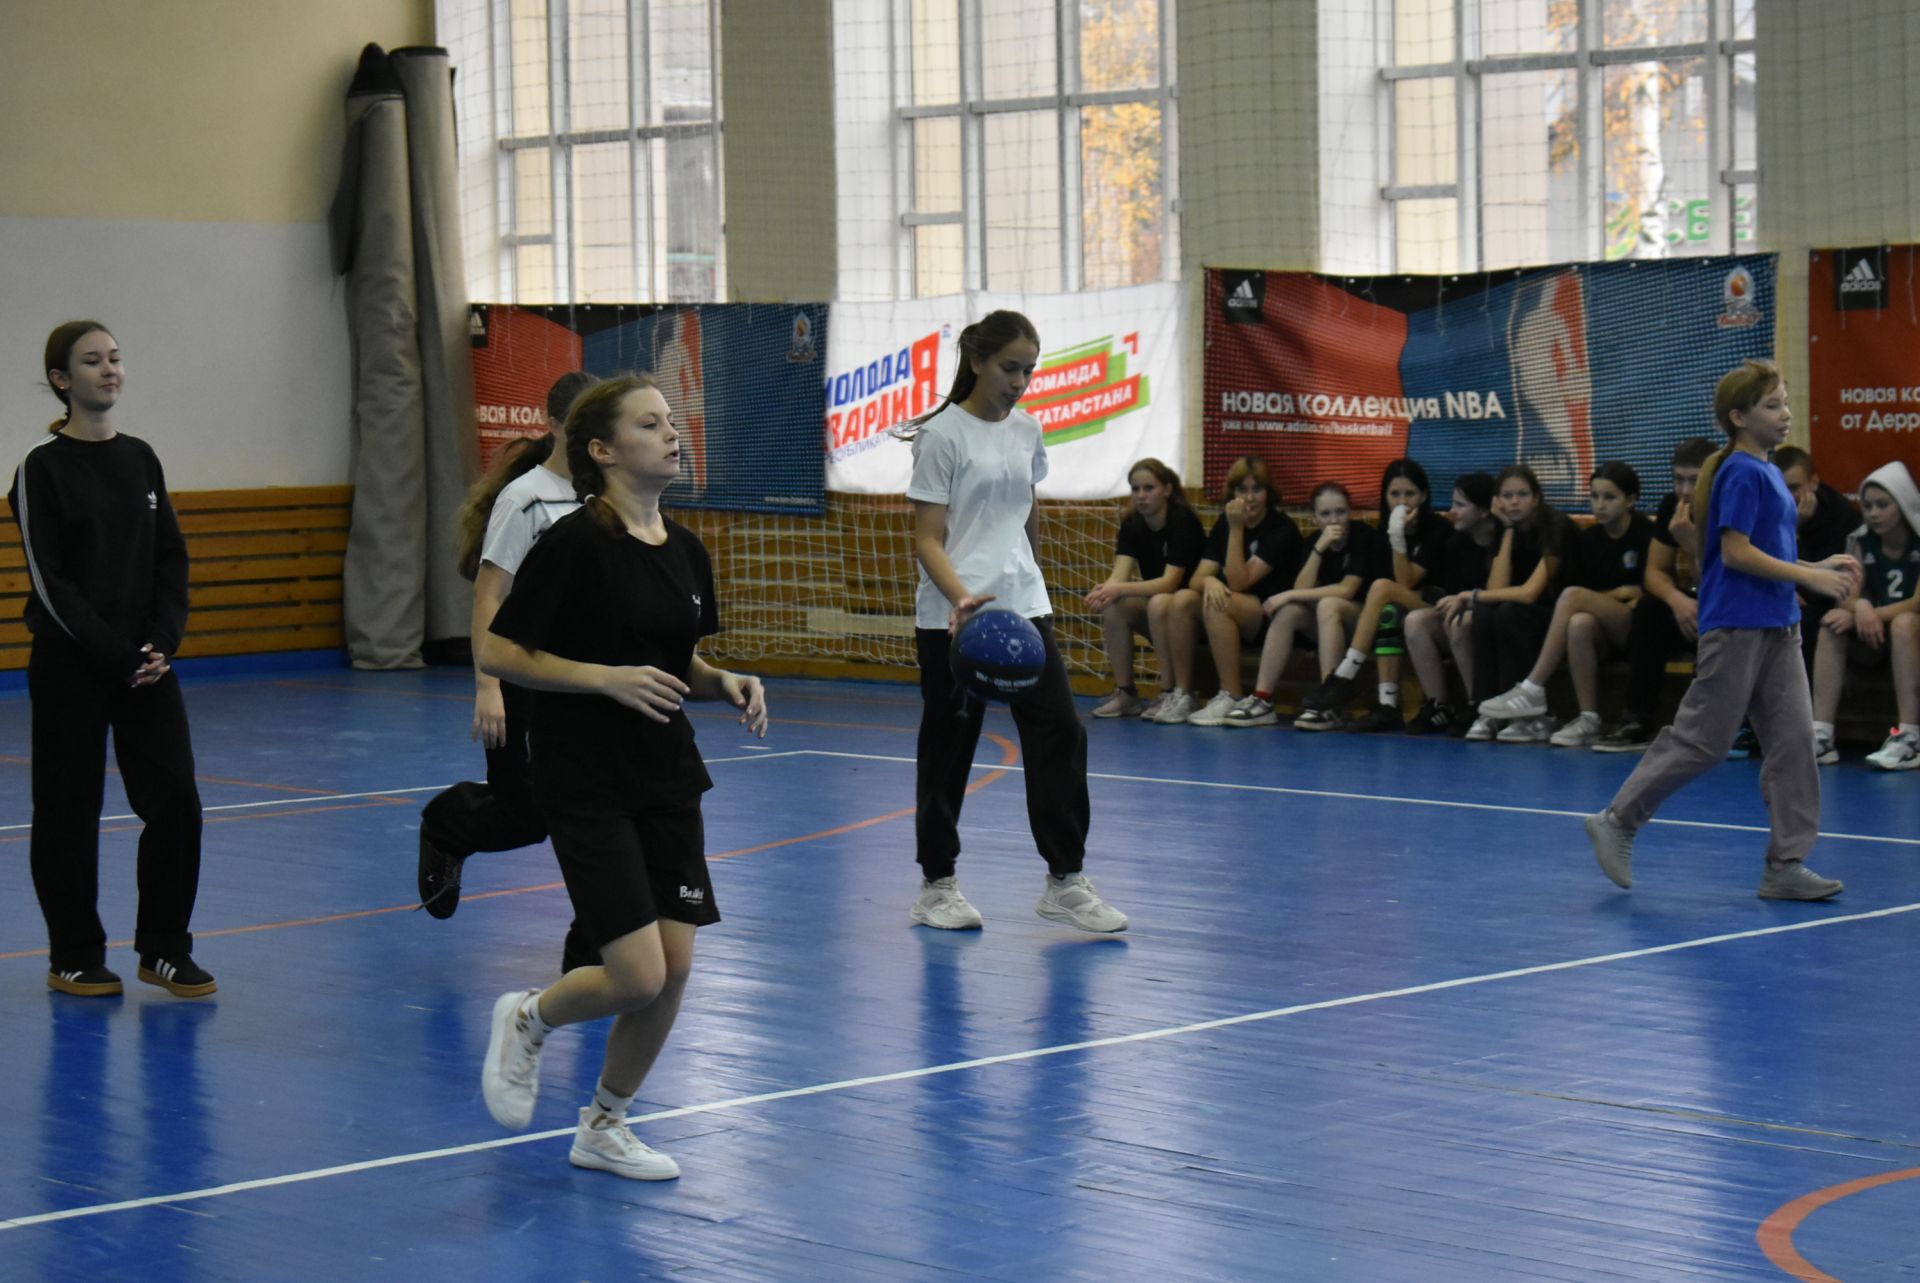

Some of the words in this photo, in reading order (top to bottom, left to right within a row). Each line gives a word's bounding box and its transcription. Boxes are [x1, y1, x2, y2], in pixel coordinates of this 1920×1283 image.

[1841, 279, 1881, 292] adidas
[1444, 390, 1506, 419] NBA
[1841, 413, 1862, 430] от
[1886, 568, 1904, 598] 2
